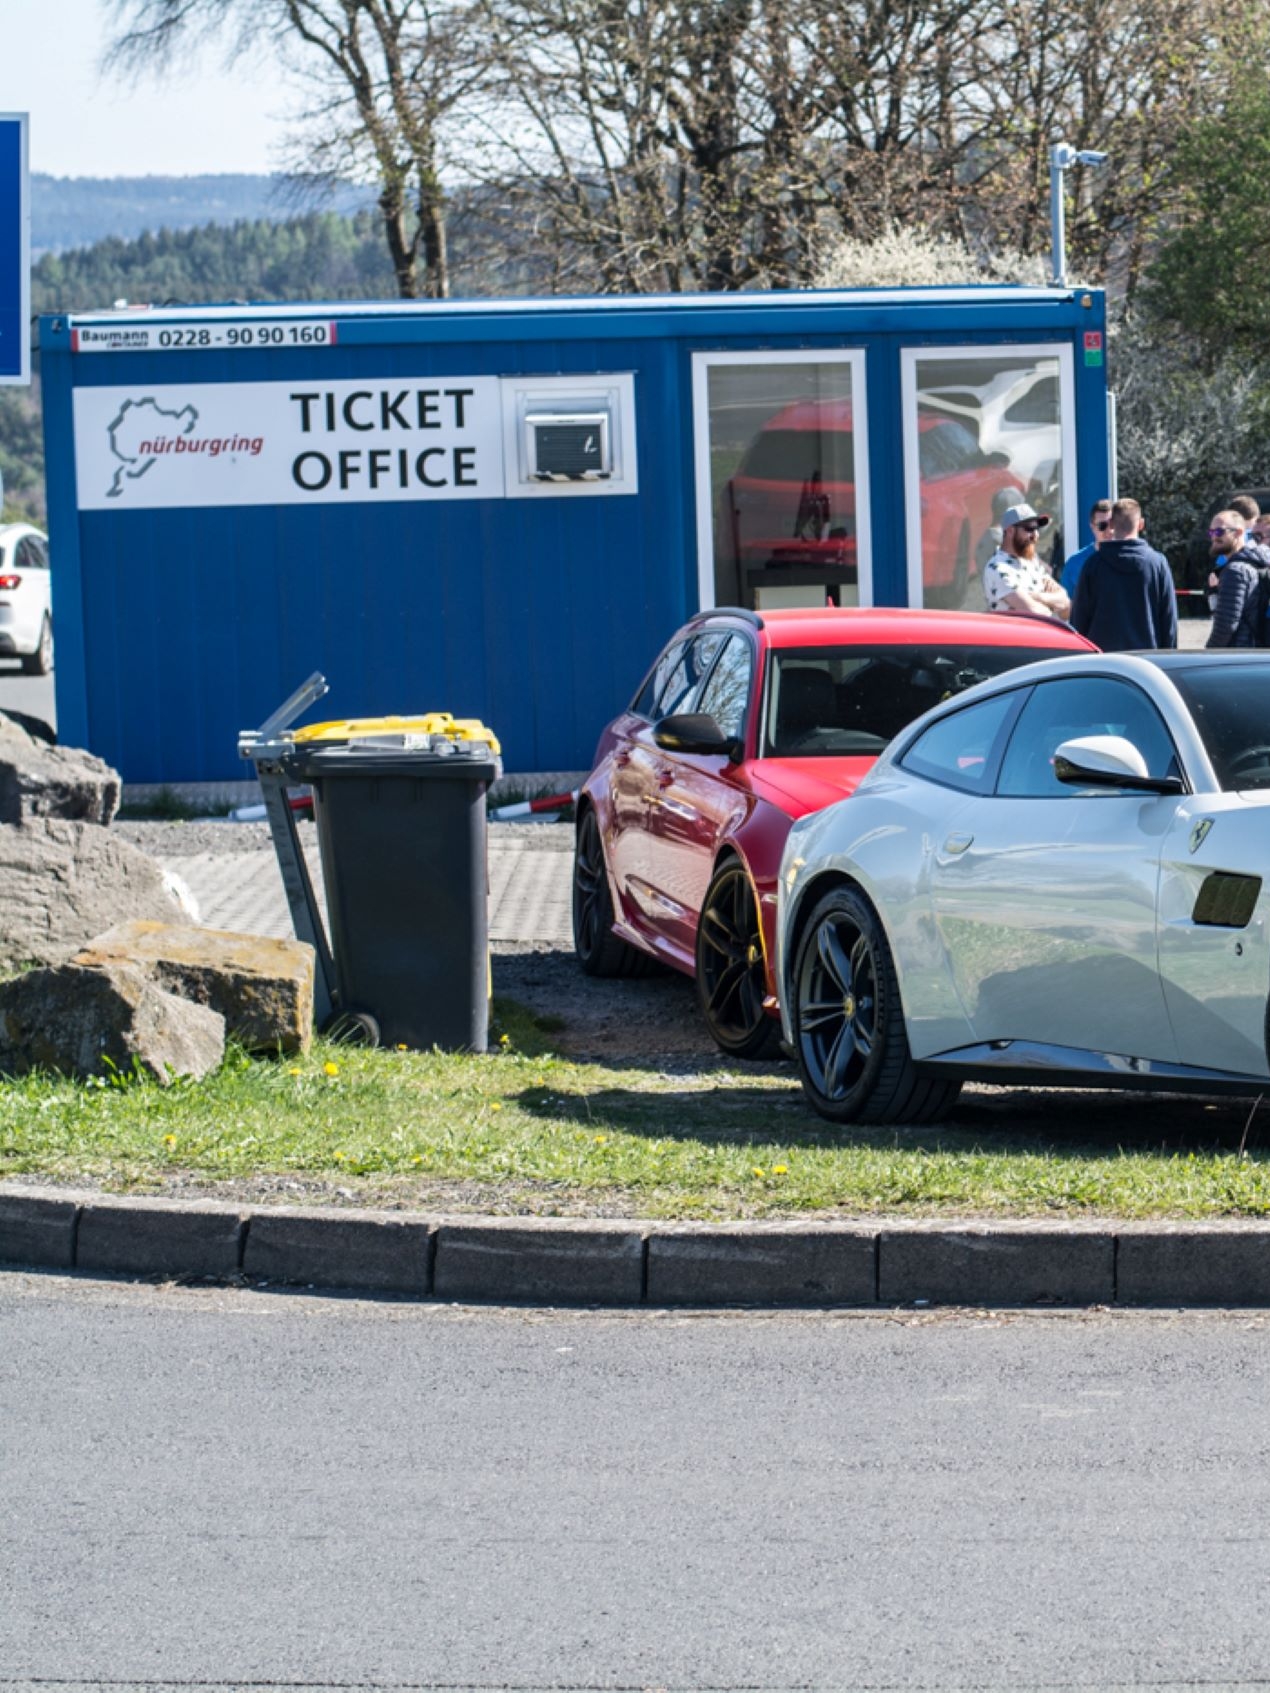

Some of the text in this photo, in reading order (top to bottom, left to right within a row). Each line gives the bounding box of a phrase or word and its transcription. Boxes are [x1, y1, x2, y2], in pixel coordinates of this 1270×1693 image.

[81, 330, 149, 342] Baumann
[159, 329, 211, 346] 0228
[227, 328, 253, 345] 90
[258, 327, 284, 344] 90
[289, 326, 327, 343] 160
[290, 389, 474, 432] TICKET
[139, 435, 264, 456] nürburgring
[292, 447, 478, 491] OFFICE
